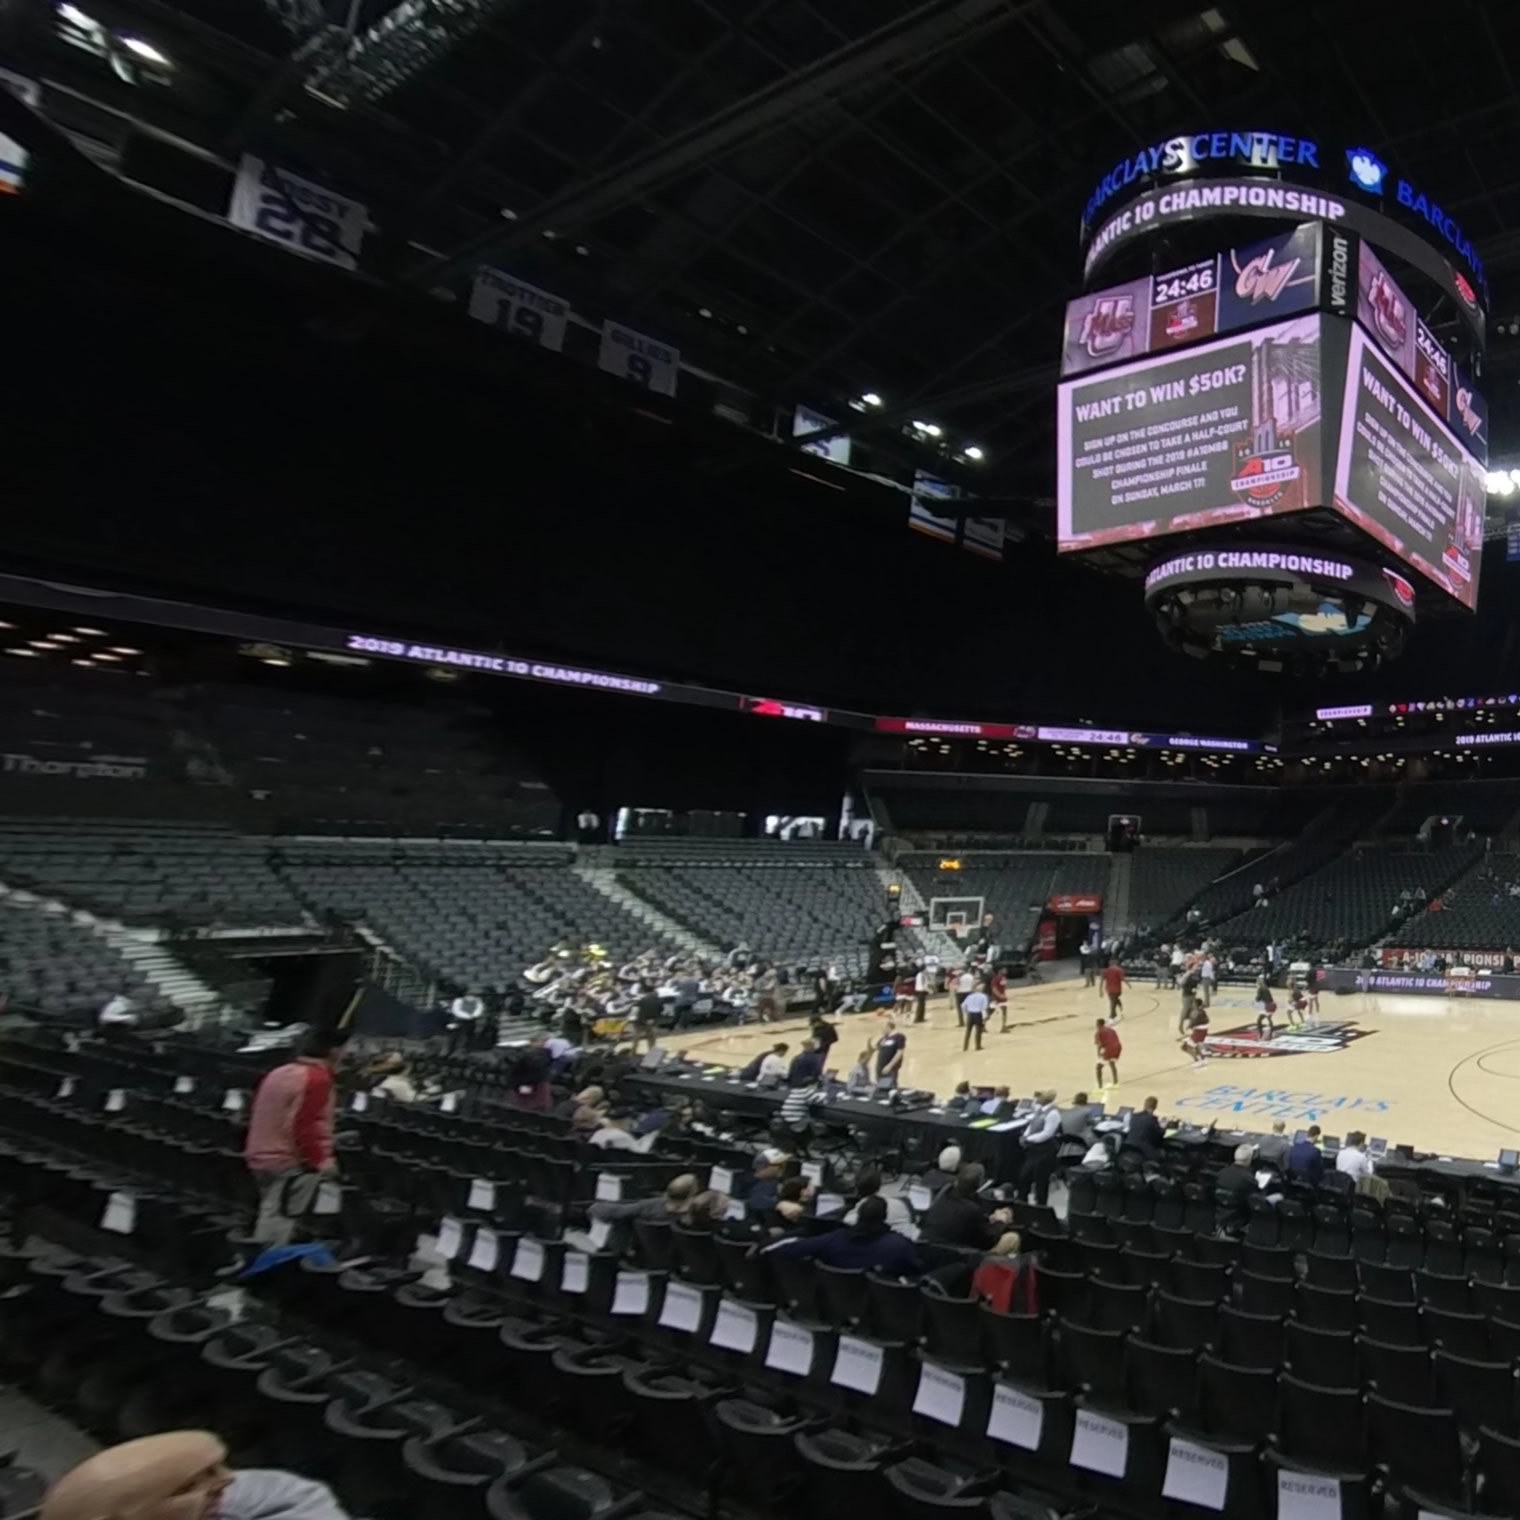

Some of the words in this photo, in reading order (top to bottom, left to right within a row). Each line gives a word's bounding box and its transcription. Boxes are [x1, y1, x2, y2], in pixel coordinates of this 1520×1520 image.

[1082, 137, 1186, 226] BARCLAYS
[1191, 131, 1320, 168] CENTER
[1134, 201, 1155, 224] 10
[1159, 186, 1346, 220] CHAMPIONSHIP
[1154, 269, 1213, 302] 24:46
[1331, 237, 1348, 306] verizon
[1415, 326, 1448, 378] 24:46
[1076, 396, 1122, 422] WANT
[1124, 390, 1147, 410] TO
[1150, 380, 1185, 403] WIN
[1189, 365, 1246, 396] $50K?
[1362, 366, 1396, 414] WANT
[1396, 403, 1411, 431] TO
[1412, 418, 1432, 451] WIN
[1130, 428, 1146, 441] THE
[1220, 406, 1238, 418] YOU
[1196, 554, 1214, 569] 10
[1217, 552, 1353, 580] CHAMPIONSHIP
[348, 635, 404, 656] 2019
[408, 644, 503, 672] ATLANTIC
[507, 660, 529, 676] 10
[532, 663, 660, 694] CHAMPIONSHIP
[905, 720, 983, 734] MASSACHUSETTS
[1475, 732, 1512, 744] ATLANTIC
[1376, 976, 1414, 988] ATLANTIC
[1415, 977, 1425, 988] 10
[1175, 1096, 1330, 1121] CENTER
[1205, 1085, 1399, 1113] BARCLAYS
[996, 1393, 1040, 1414] RESERVED
[1171, 1447, 1226, 1470] RESERVED
[1280, 1479, 1337, 1499] RESERVED
